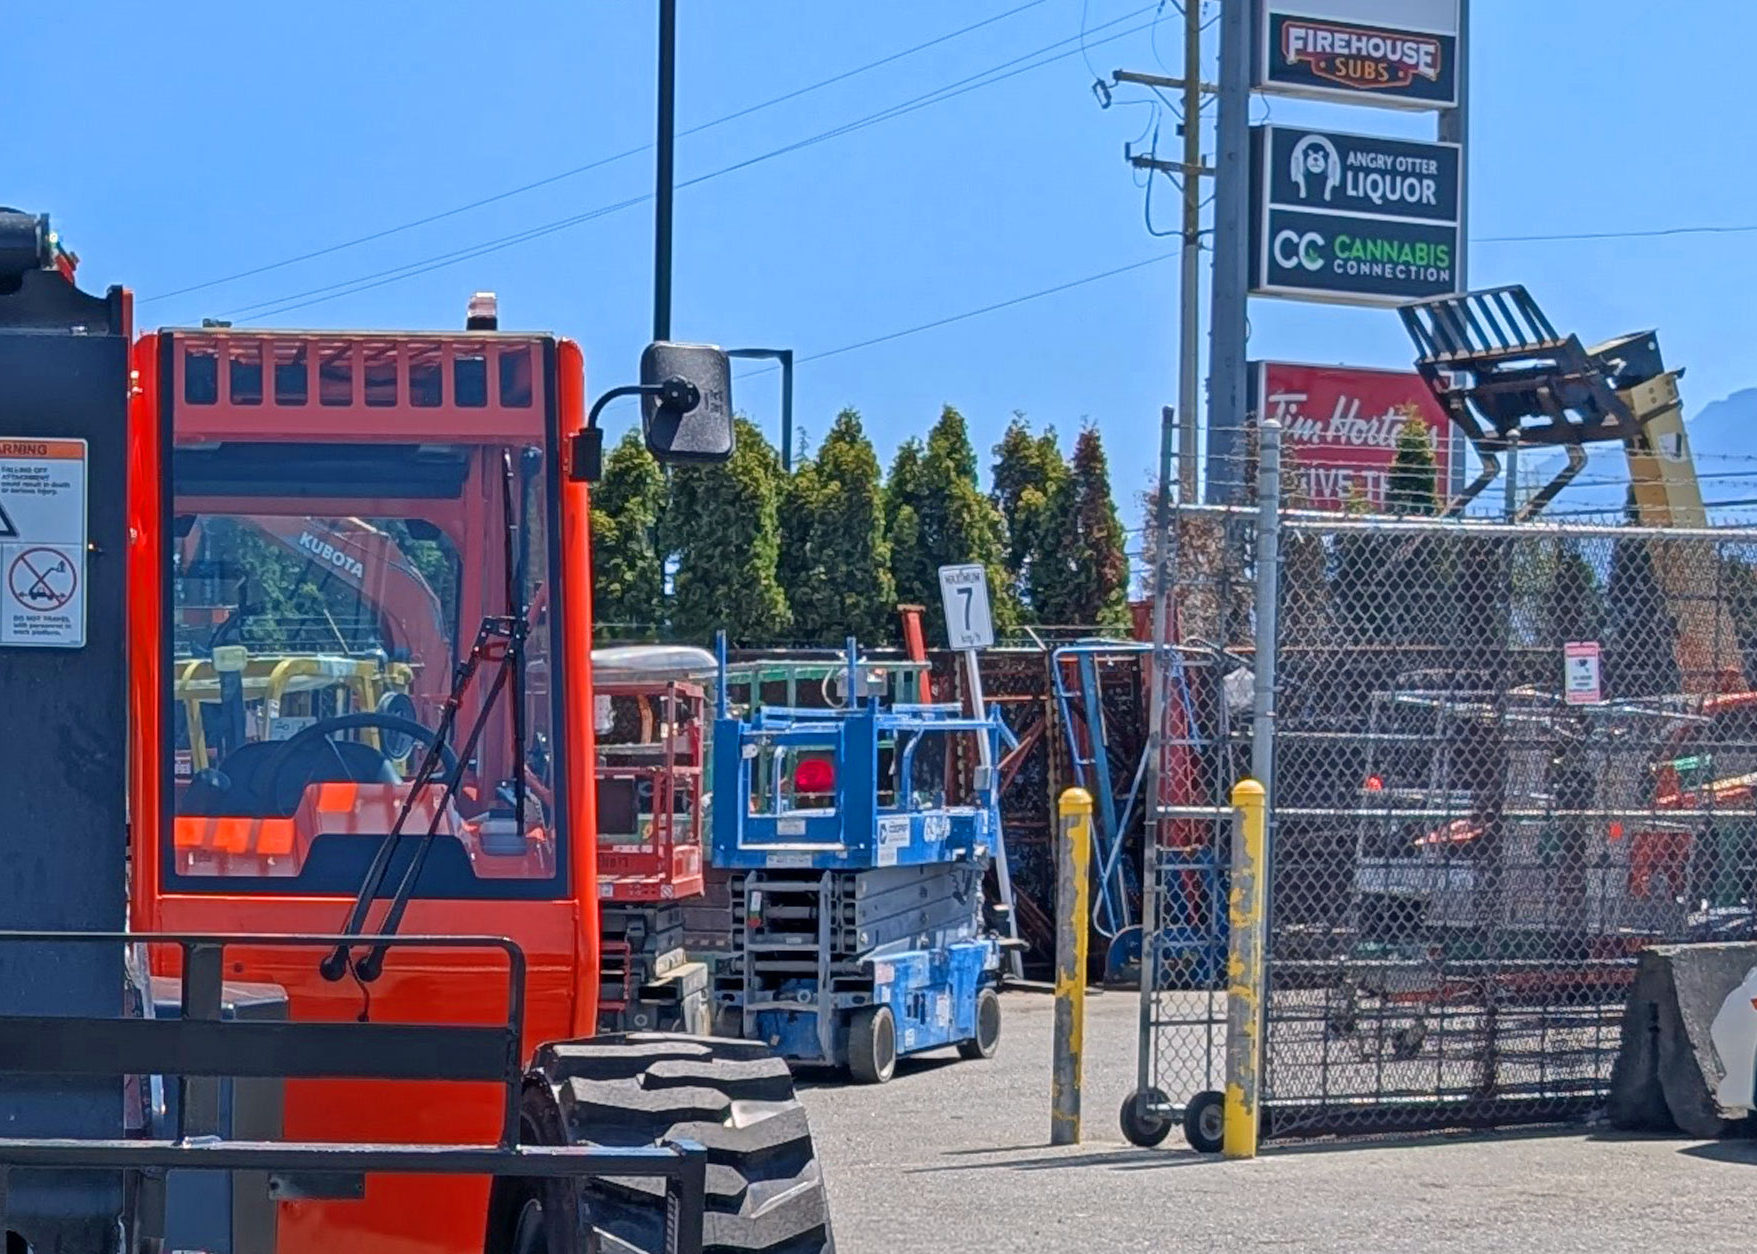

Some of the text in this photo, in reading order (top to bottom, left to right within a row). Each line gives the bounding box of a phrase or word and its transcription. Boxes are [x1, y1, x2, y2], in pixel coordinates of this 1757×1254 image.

[1287, 27, 1438, 76] FIREHOUSE
[1335, 57, 1390, 82] SUBS
[1346, 151, 1438, 175] ANGRY OTTER
[1346, 172, 1437, 205] LIQUOR
[1274, 229, 1325, 271] CC
[1334, 235, 1450, 267] CANNABIS
[1334, 258, 1450, 281] CONNECTION
[1268, 394, 1324, 444] Tim
[300, 531, 363, 578] KUBOTA
[957, 587, 973, 631] 7
